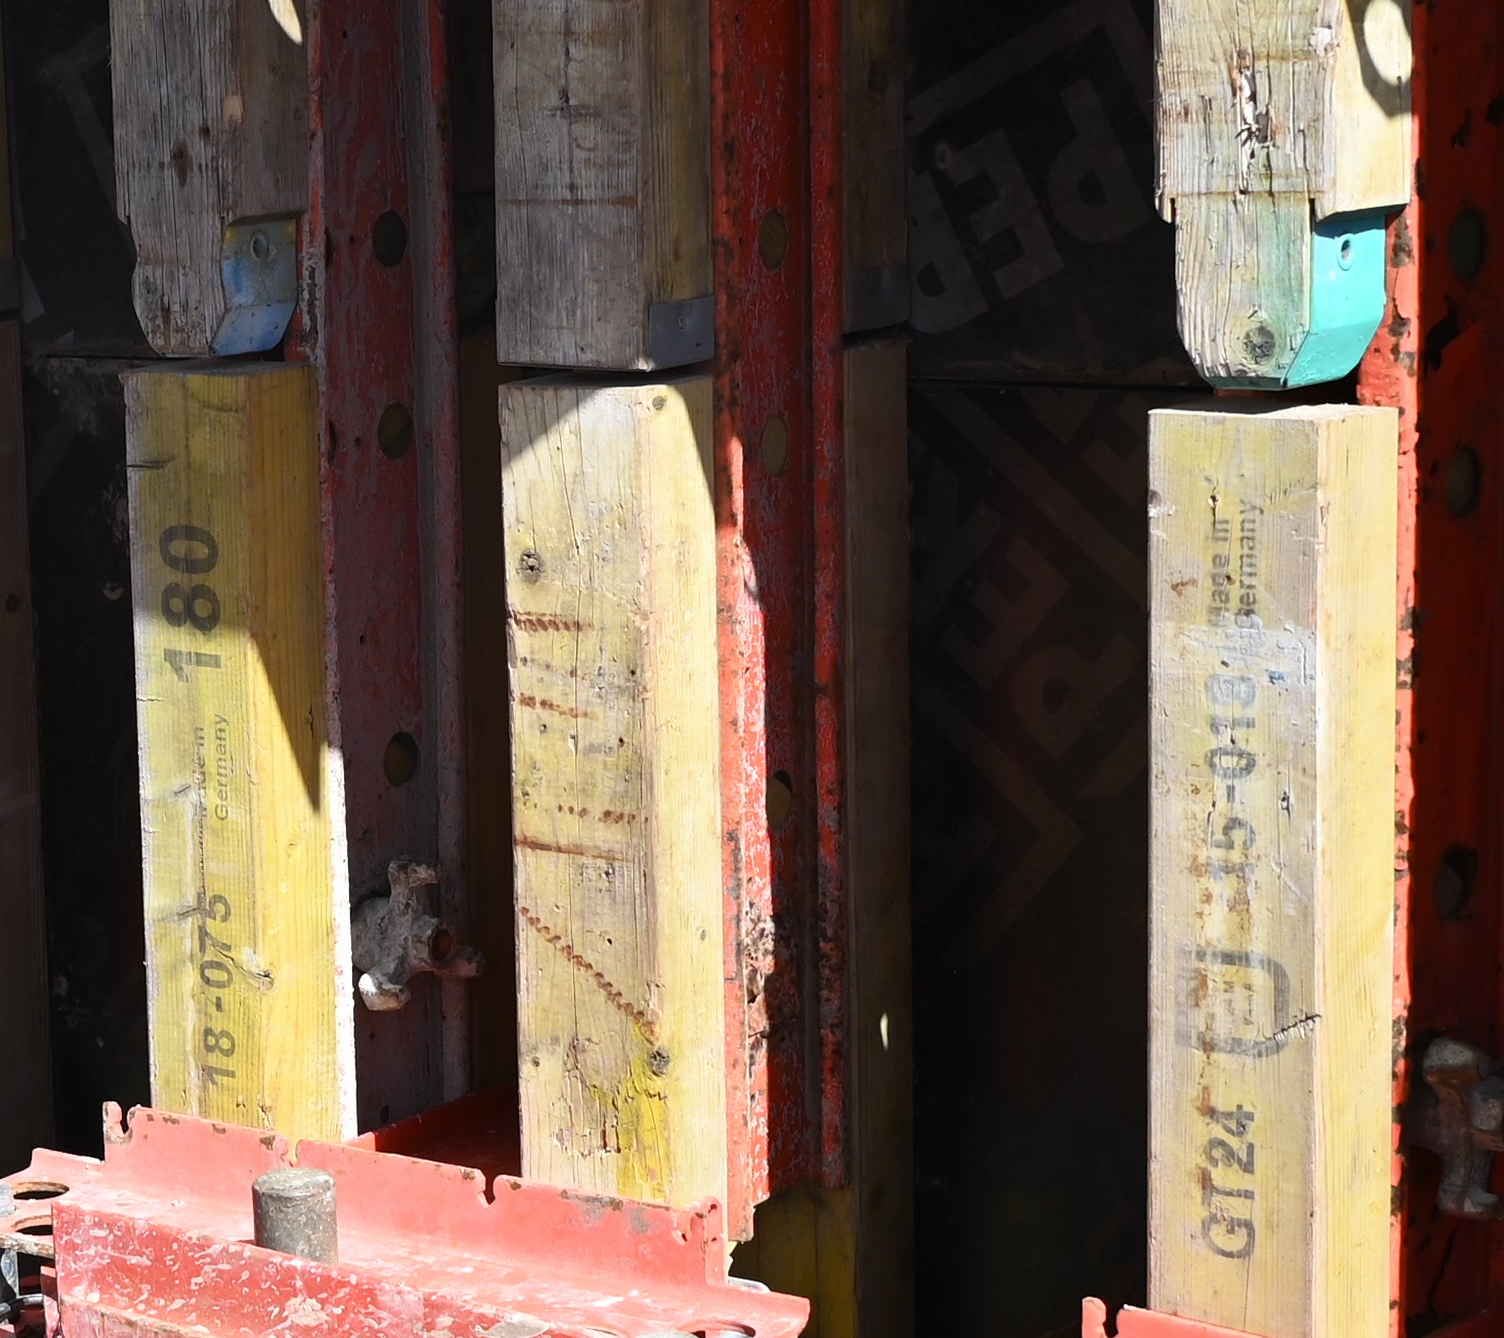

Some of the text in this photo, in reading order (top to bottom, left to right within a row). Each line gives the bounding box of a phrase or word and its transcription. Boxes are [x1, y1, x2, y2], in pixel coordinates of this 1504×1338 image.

[158, 525, 221, 684] 180
[213, 713, 230, 821] Germany
[1199, 1103, 1255, 1261] GT24
